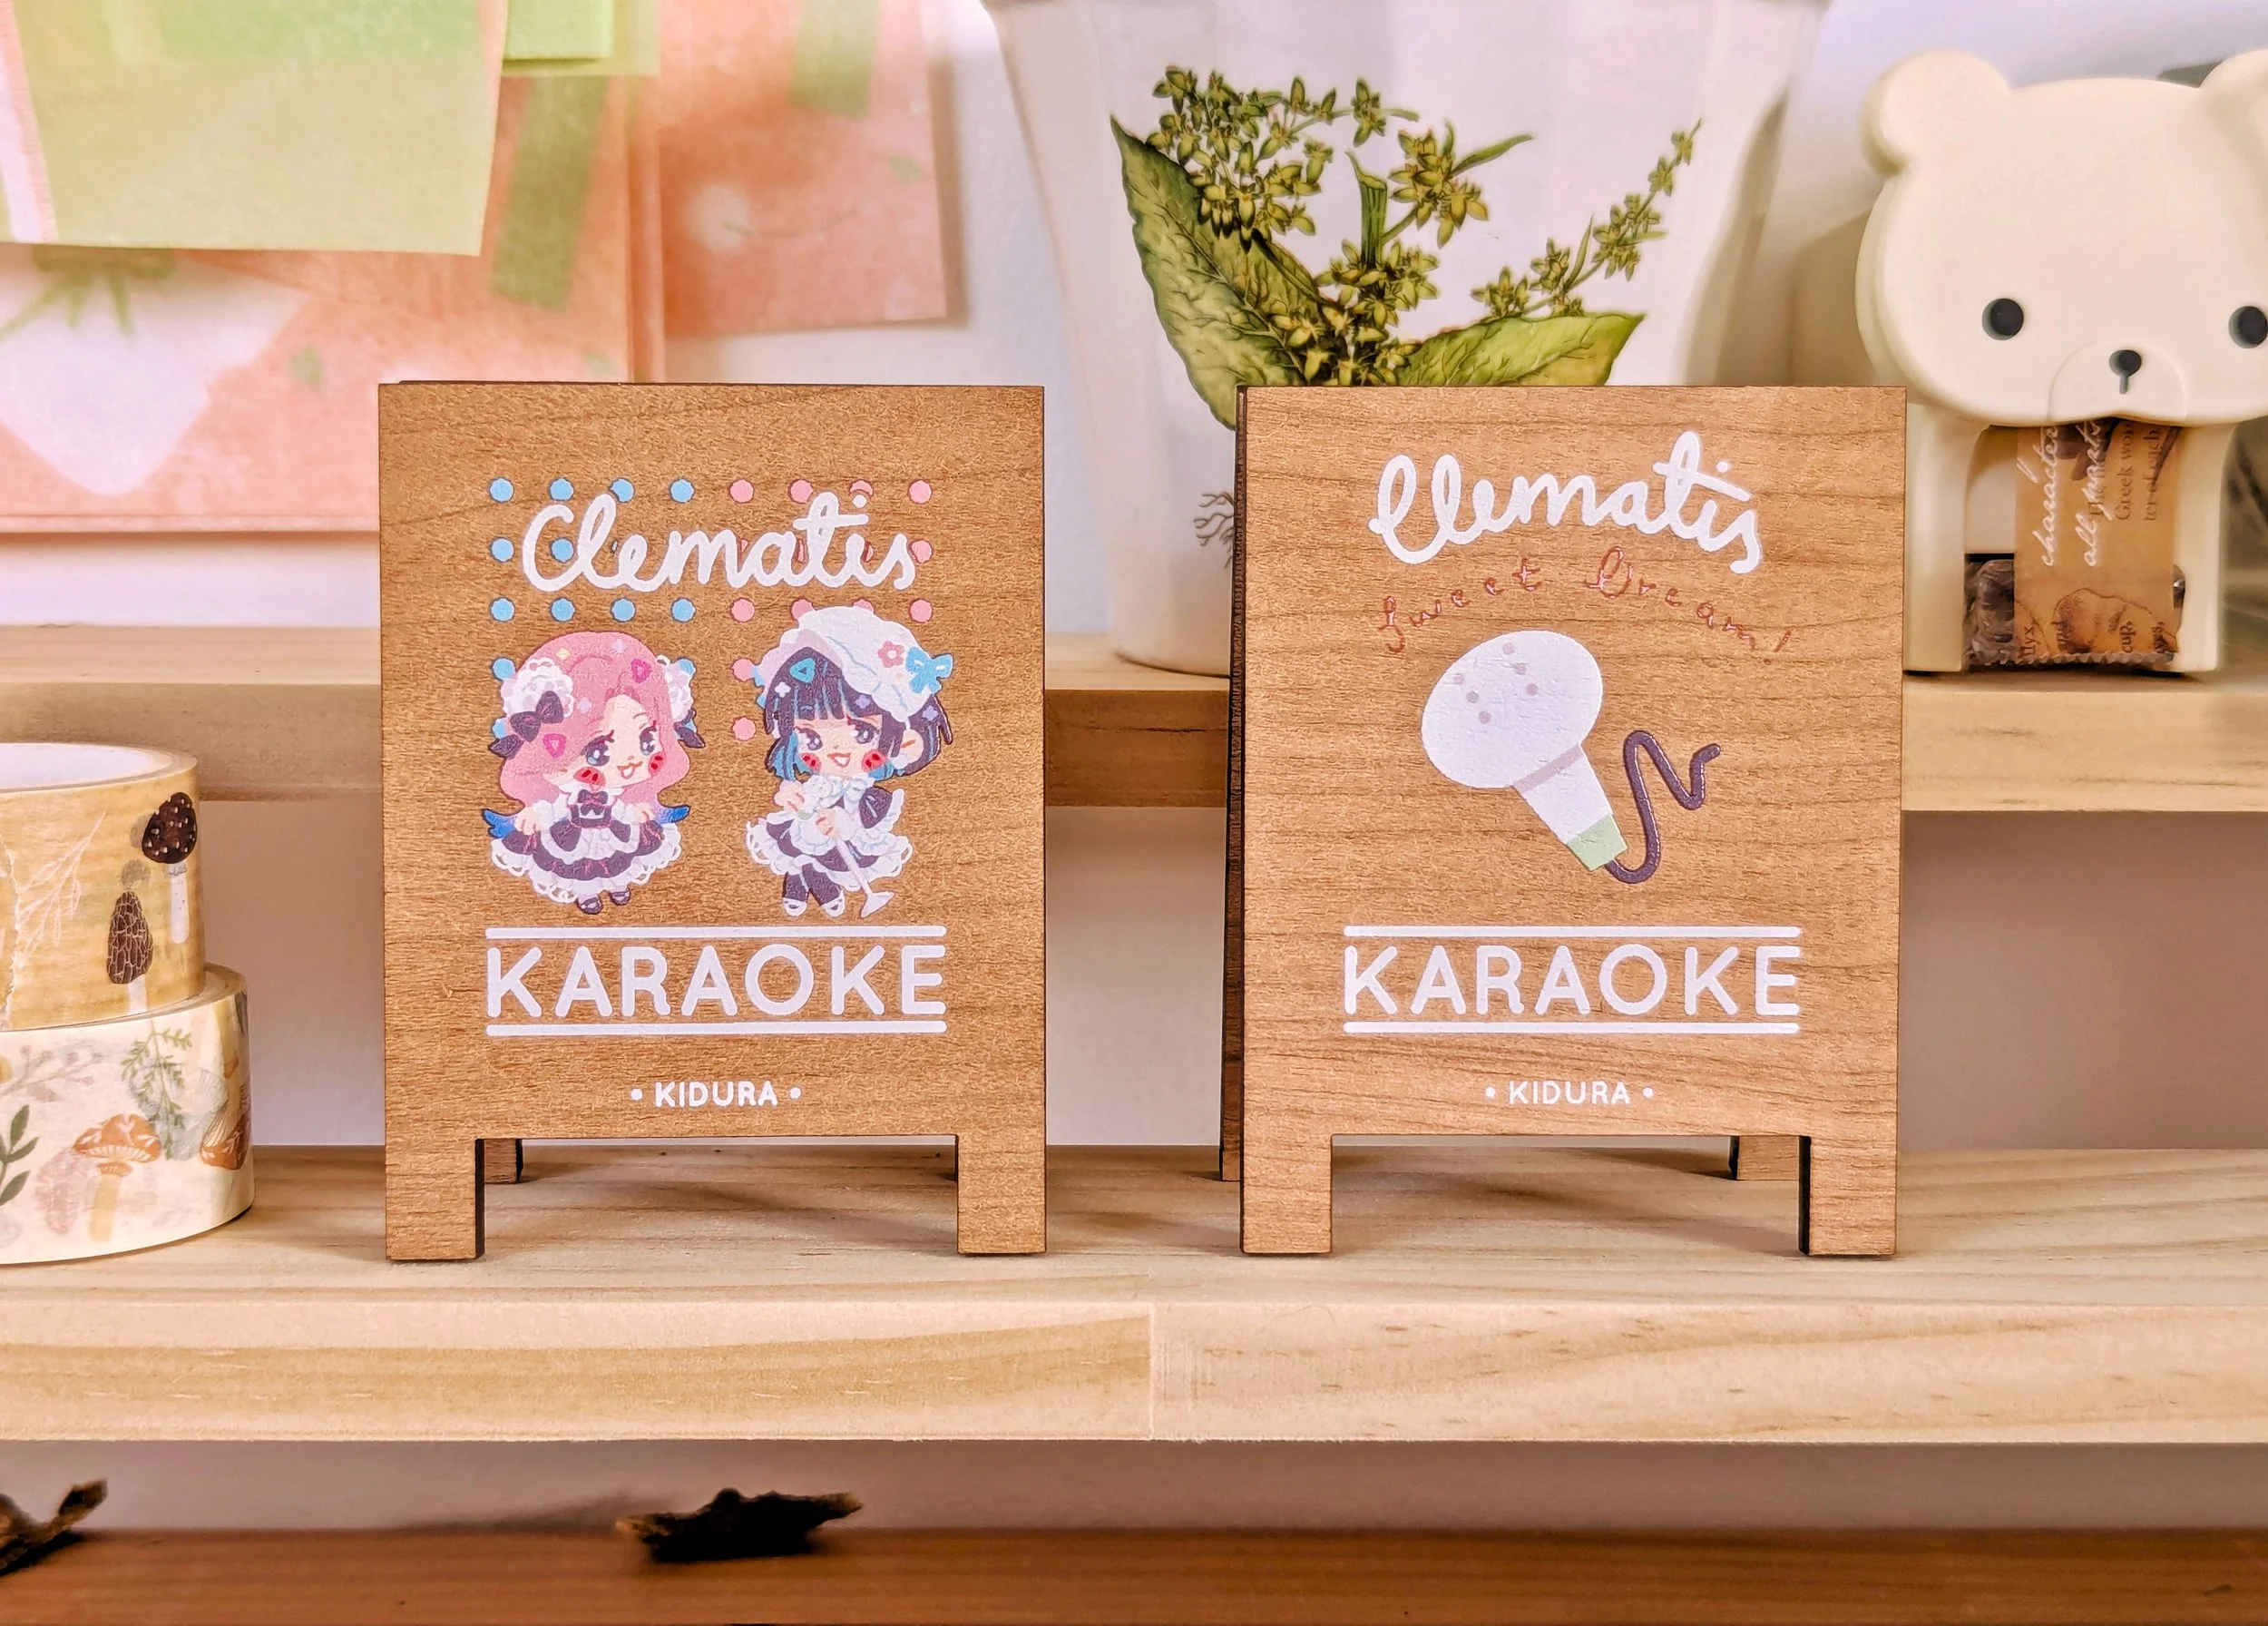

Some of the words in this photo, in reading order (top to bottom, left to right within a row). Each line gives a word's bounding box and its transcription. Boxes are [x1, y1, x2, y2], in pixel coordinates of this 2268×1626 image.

[2115, 465, 2134, 520] Greek
[522, 490, 917, 593] Clematis
[2074, 512, 2098, 567] all
[485, 944, 946, 1017] KARAOKE
[1344, 944, 1801, 1016] KARAOKE
[654, 1081, 778, 1108] KIDURA
[1508, 1081, 1631, 1106] KIDURA
